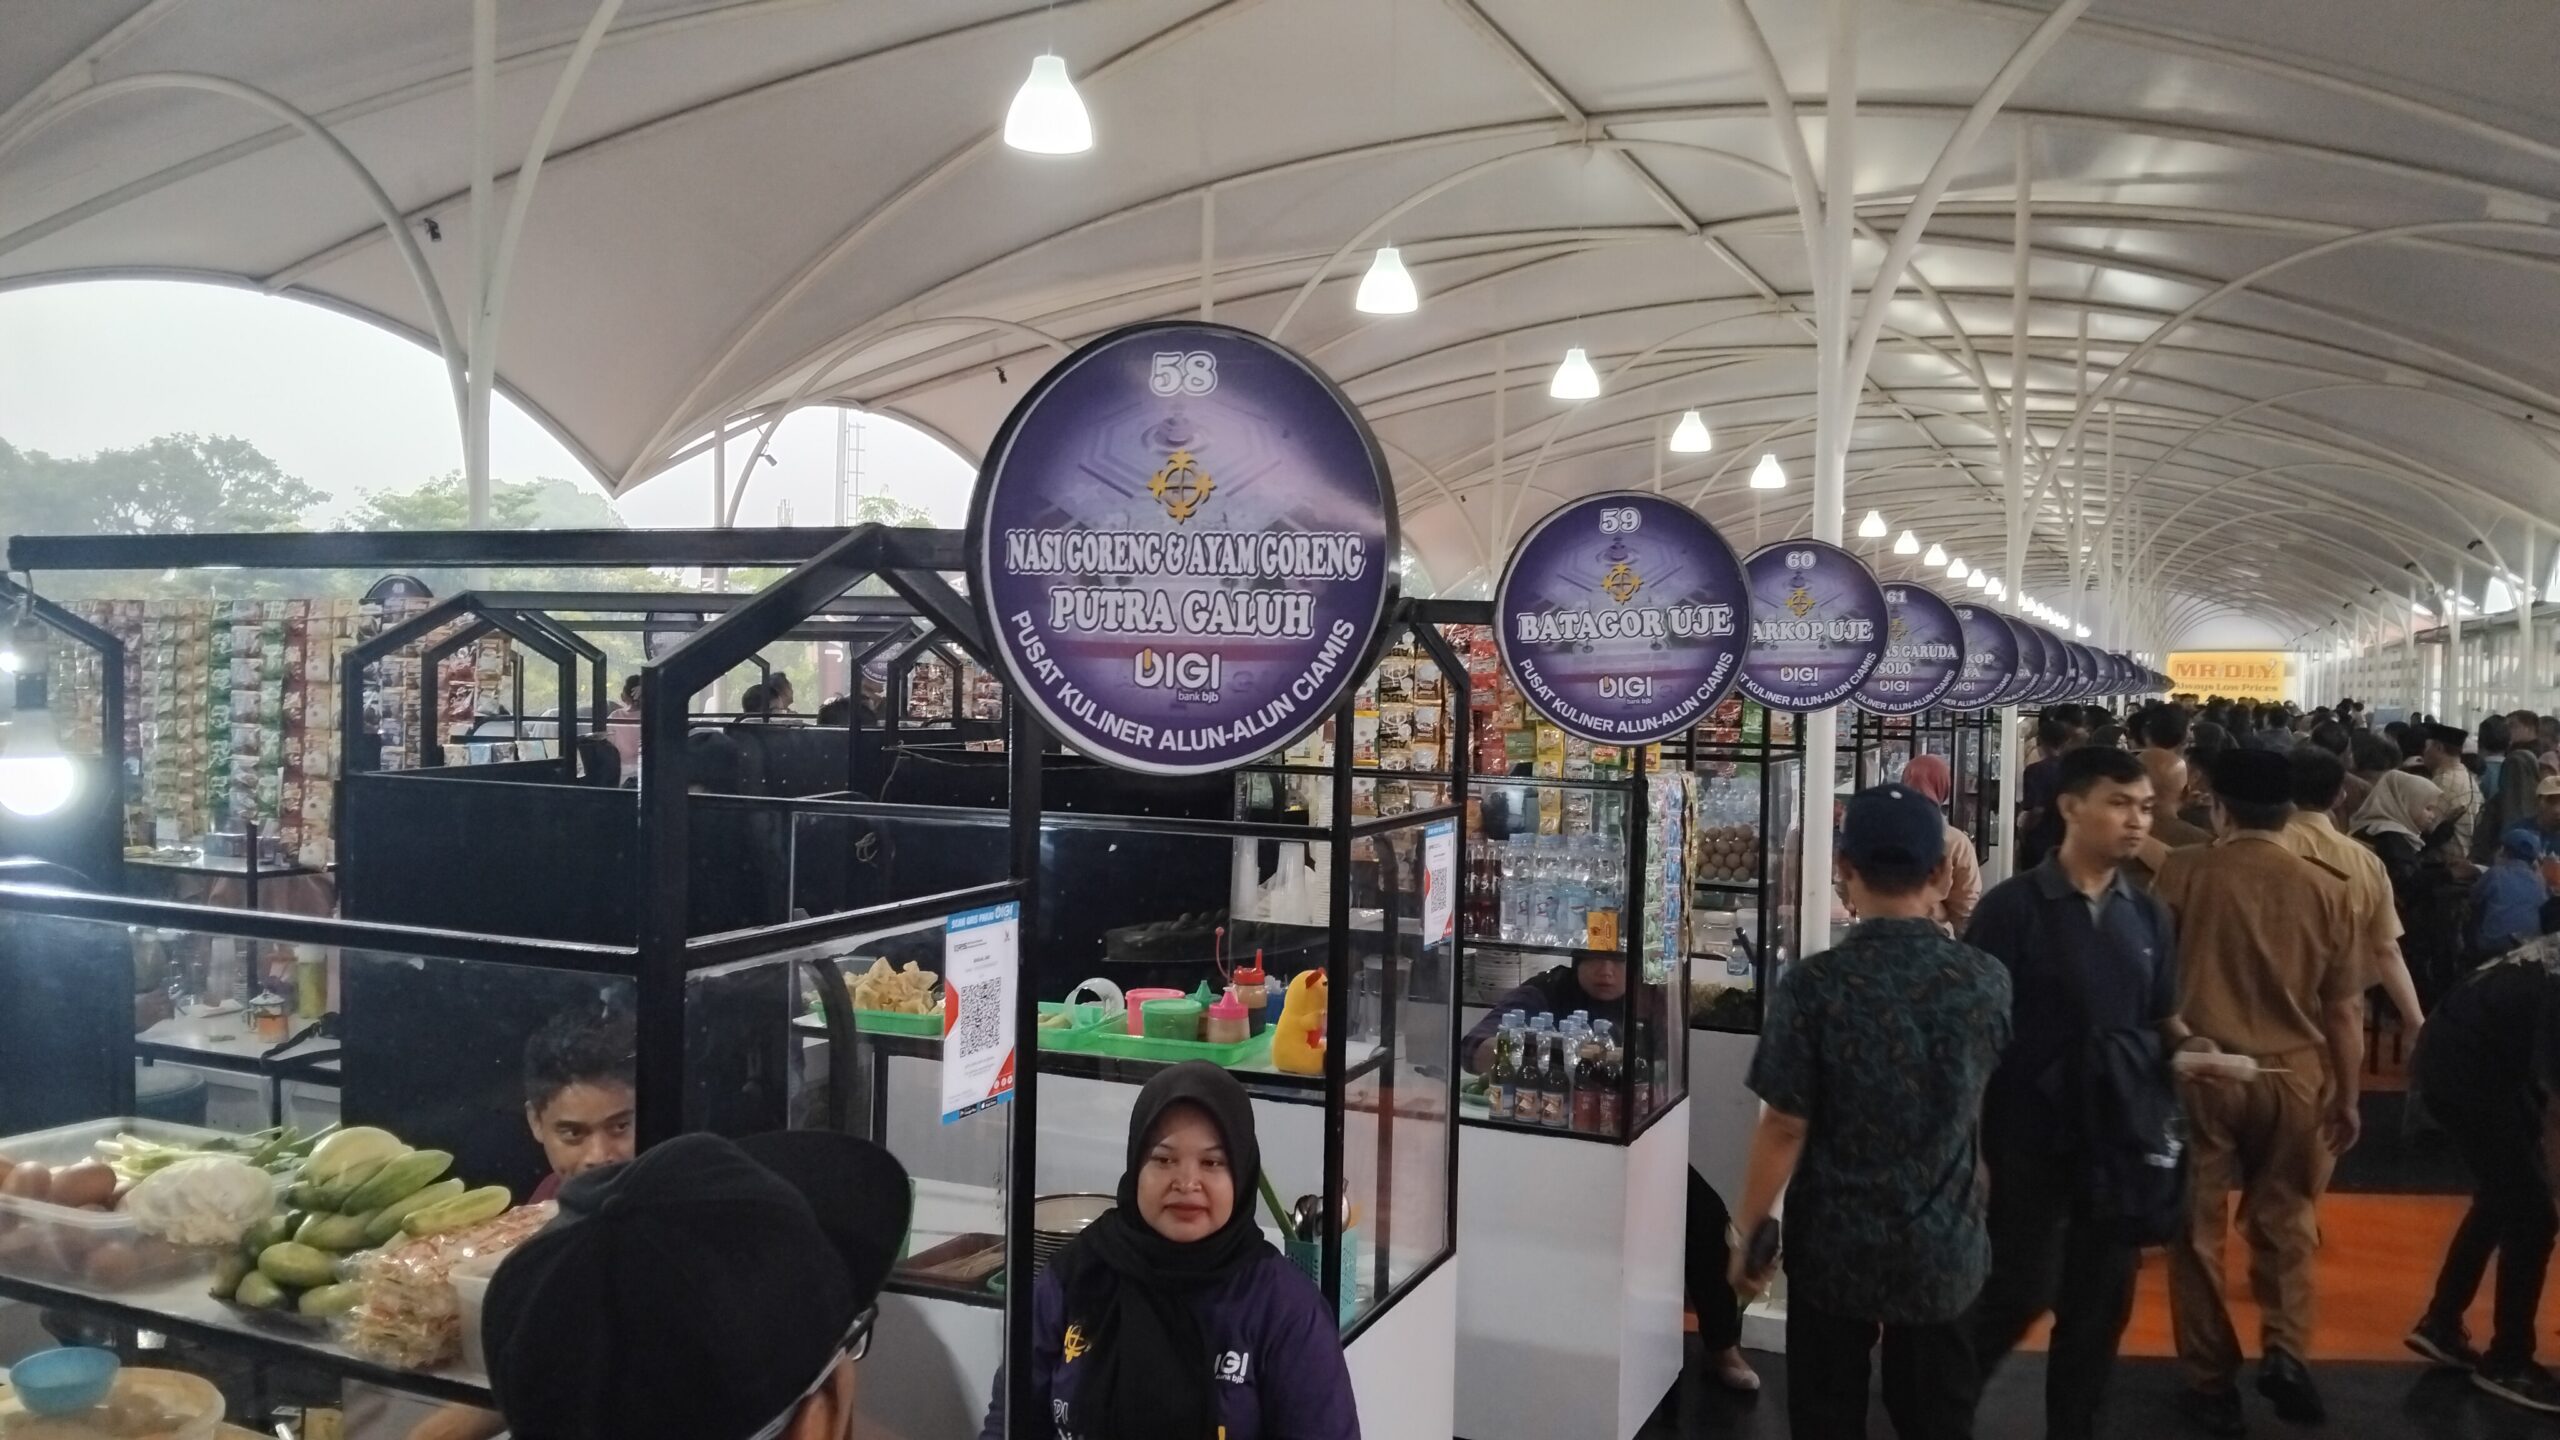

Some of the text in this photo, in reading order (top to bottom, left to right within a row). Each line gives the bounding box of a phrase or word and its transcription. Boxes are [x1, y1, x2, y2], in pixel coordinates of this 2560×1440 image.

[1149, 350, 1217, 396] 58
[1599, 507, 1642, 534] 59
[1006, 530, 1366, 580] NASI GORENG & AYAM GORENG
[1785, 551, 1816, 570] 60
[1048, 587, 1316, 639] PUTRA GALUH
[1516, 603, 1735, 643] BATAGOR UJE
[1752, 618, 1874, 642] ARKOP UJE
[1901, 644, 1958, 659] GARUDA
[1011, 611, 1355, 751] PUSAT KULINER ALUN-ALUN CIAMIS
[1133, 648, 1221, 688] DIGI
[1746, 652, 1876, 706] KULINER ALUN-ALUN CIAMIS
[1780, 666, 1819, 682] DIGI
[1178, 690, 1219, 703] bank bjb
[1519, 652, 1733, 733] PUSAT KULINER ALUN-ALUN CIAMIS
[1598, 676, 1652, 698] DIGI
[1880, 680, 1909, 691] DIGI
[1214, 1350, 1249, 1377] IGI
